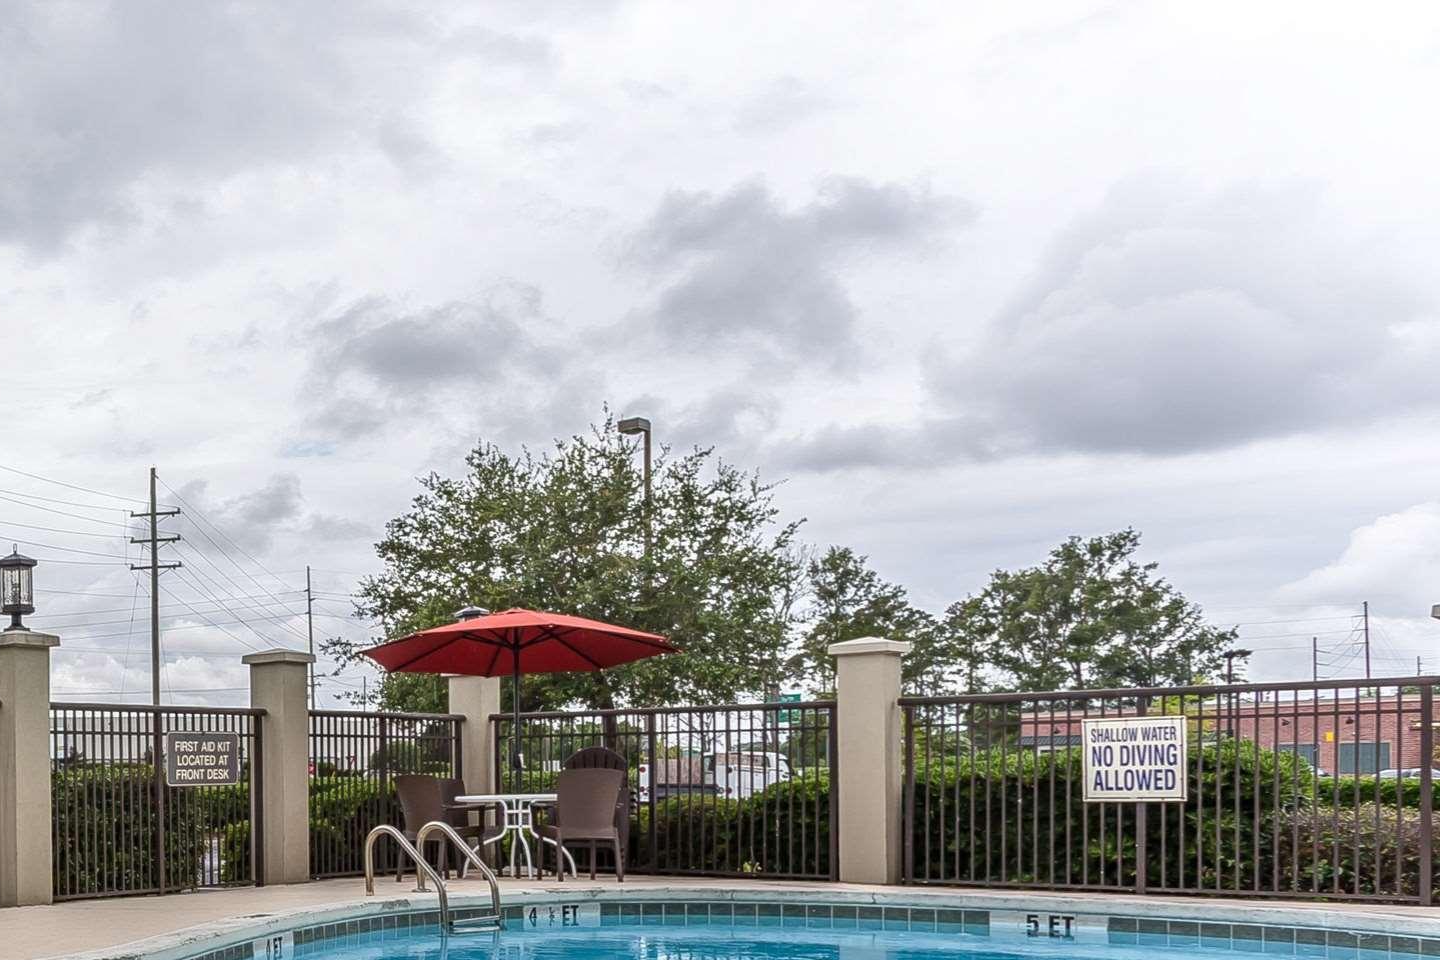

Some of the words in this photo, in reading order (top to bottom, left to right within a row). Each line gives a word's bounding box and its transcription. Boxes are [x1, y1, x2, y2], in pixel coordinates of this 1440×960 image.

[1091, 727, 1138, 743] SHALLOW
[1141, 726, 1177, 741] WATER
[174, 741, 199, 752] FIRST
[201, 741, 215, 752] AID
[217, 741, 231, 752] KIT
[177, 755, 216, 766] LOCATED
[218, 755, 229, 765] AT
[1092, 745, 1114, 767] NO
[1120, 744, 1178, 766] DIVING
[176, 769, 205, 780] FRONT
[207, 769, 229, 779] DESK
[1093, 769, 1176, 791] ALLOWED
[1027, 914, 1039, 932] 5
